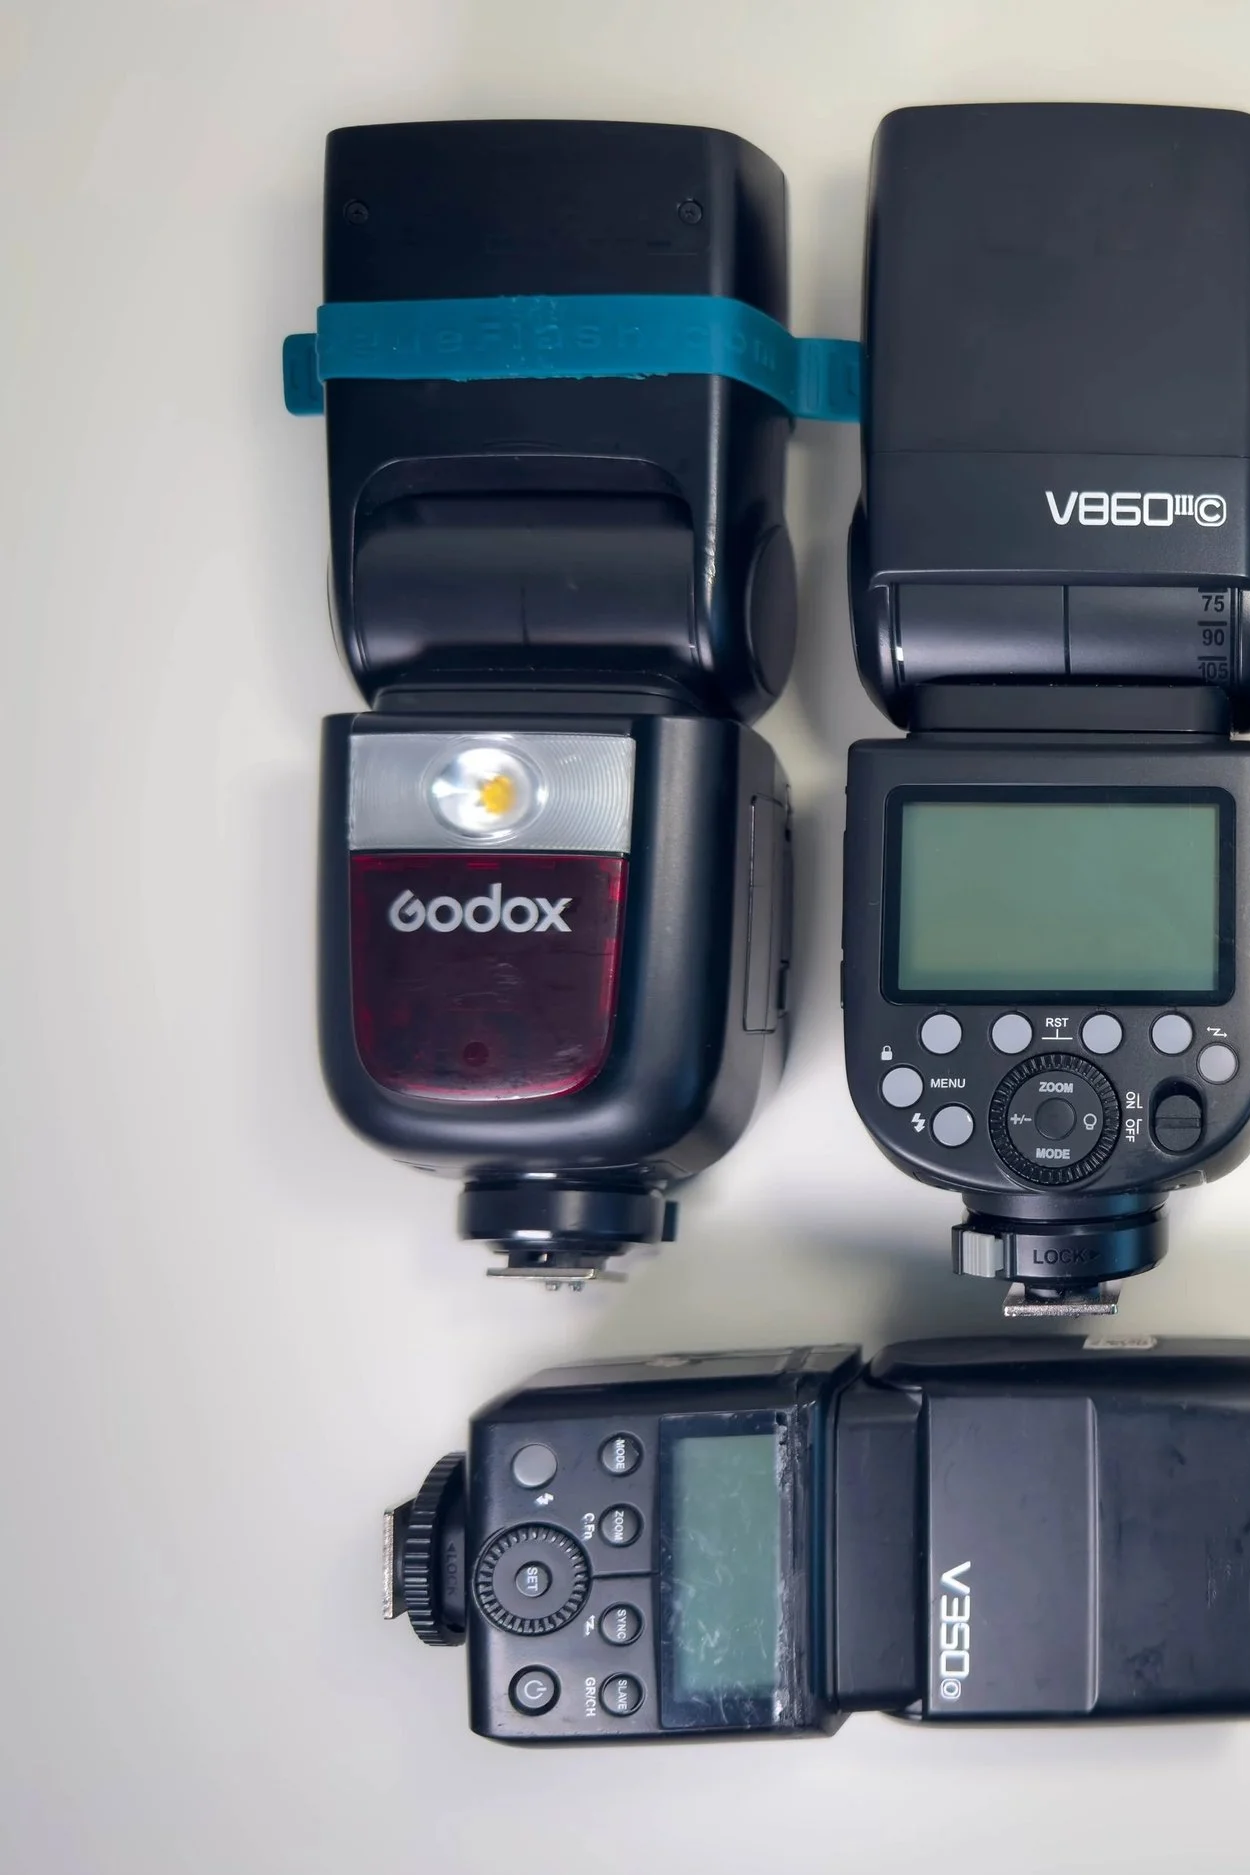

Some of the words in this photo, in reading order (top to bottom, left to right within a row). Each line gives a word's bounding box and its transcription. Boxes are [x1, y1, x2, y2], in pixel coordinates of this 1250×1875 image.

[1201, 595, 1225, 613] 75
[1201, 629, 1225, 646] 90
[1198, 662, 1228, 681] 105
[388, 883, 573, 934] Godox
[1045, 1016, 1069, 1028] RST
[931, 1078, 966, 1089] MENU
[1038, 1081, 1074, 1094] ZOOM
[1125, 1091, 1135, 1110] ON
[1125, 1118, 1135, 1143] OFF
[1036, 1147, 1071, 1160] MODE
[1033, 1249, 1087, 1265] LOCK
[615, 1439, 625, 1470] MODE
[614, 1511, 624, 1541] ZOOM
[445, 1554, 457, 1596] LOCK
[526, 1566, 538, 1592] SET
[616, 1609, 627, 1640] SYNC
[585, 1676, 596, 1716] GR/CH
[617, 1679, 628, 1711] SLAVE
